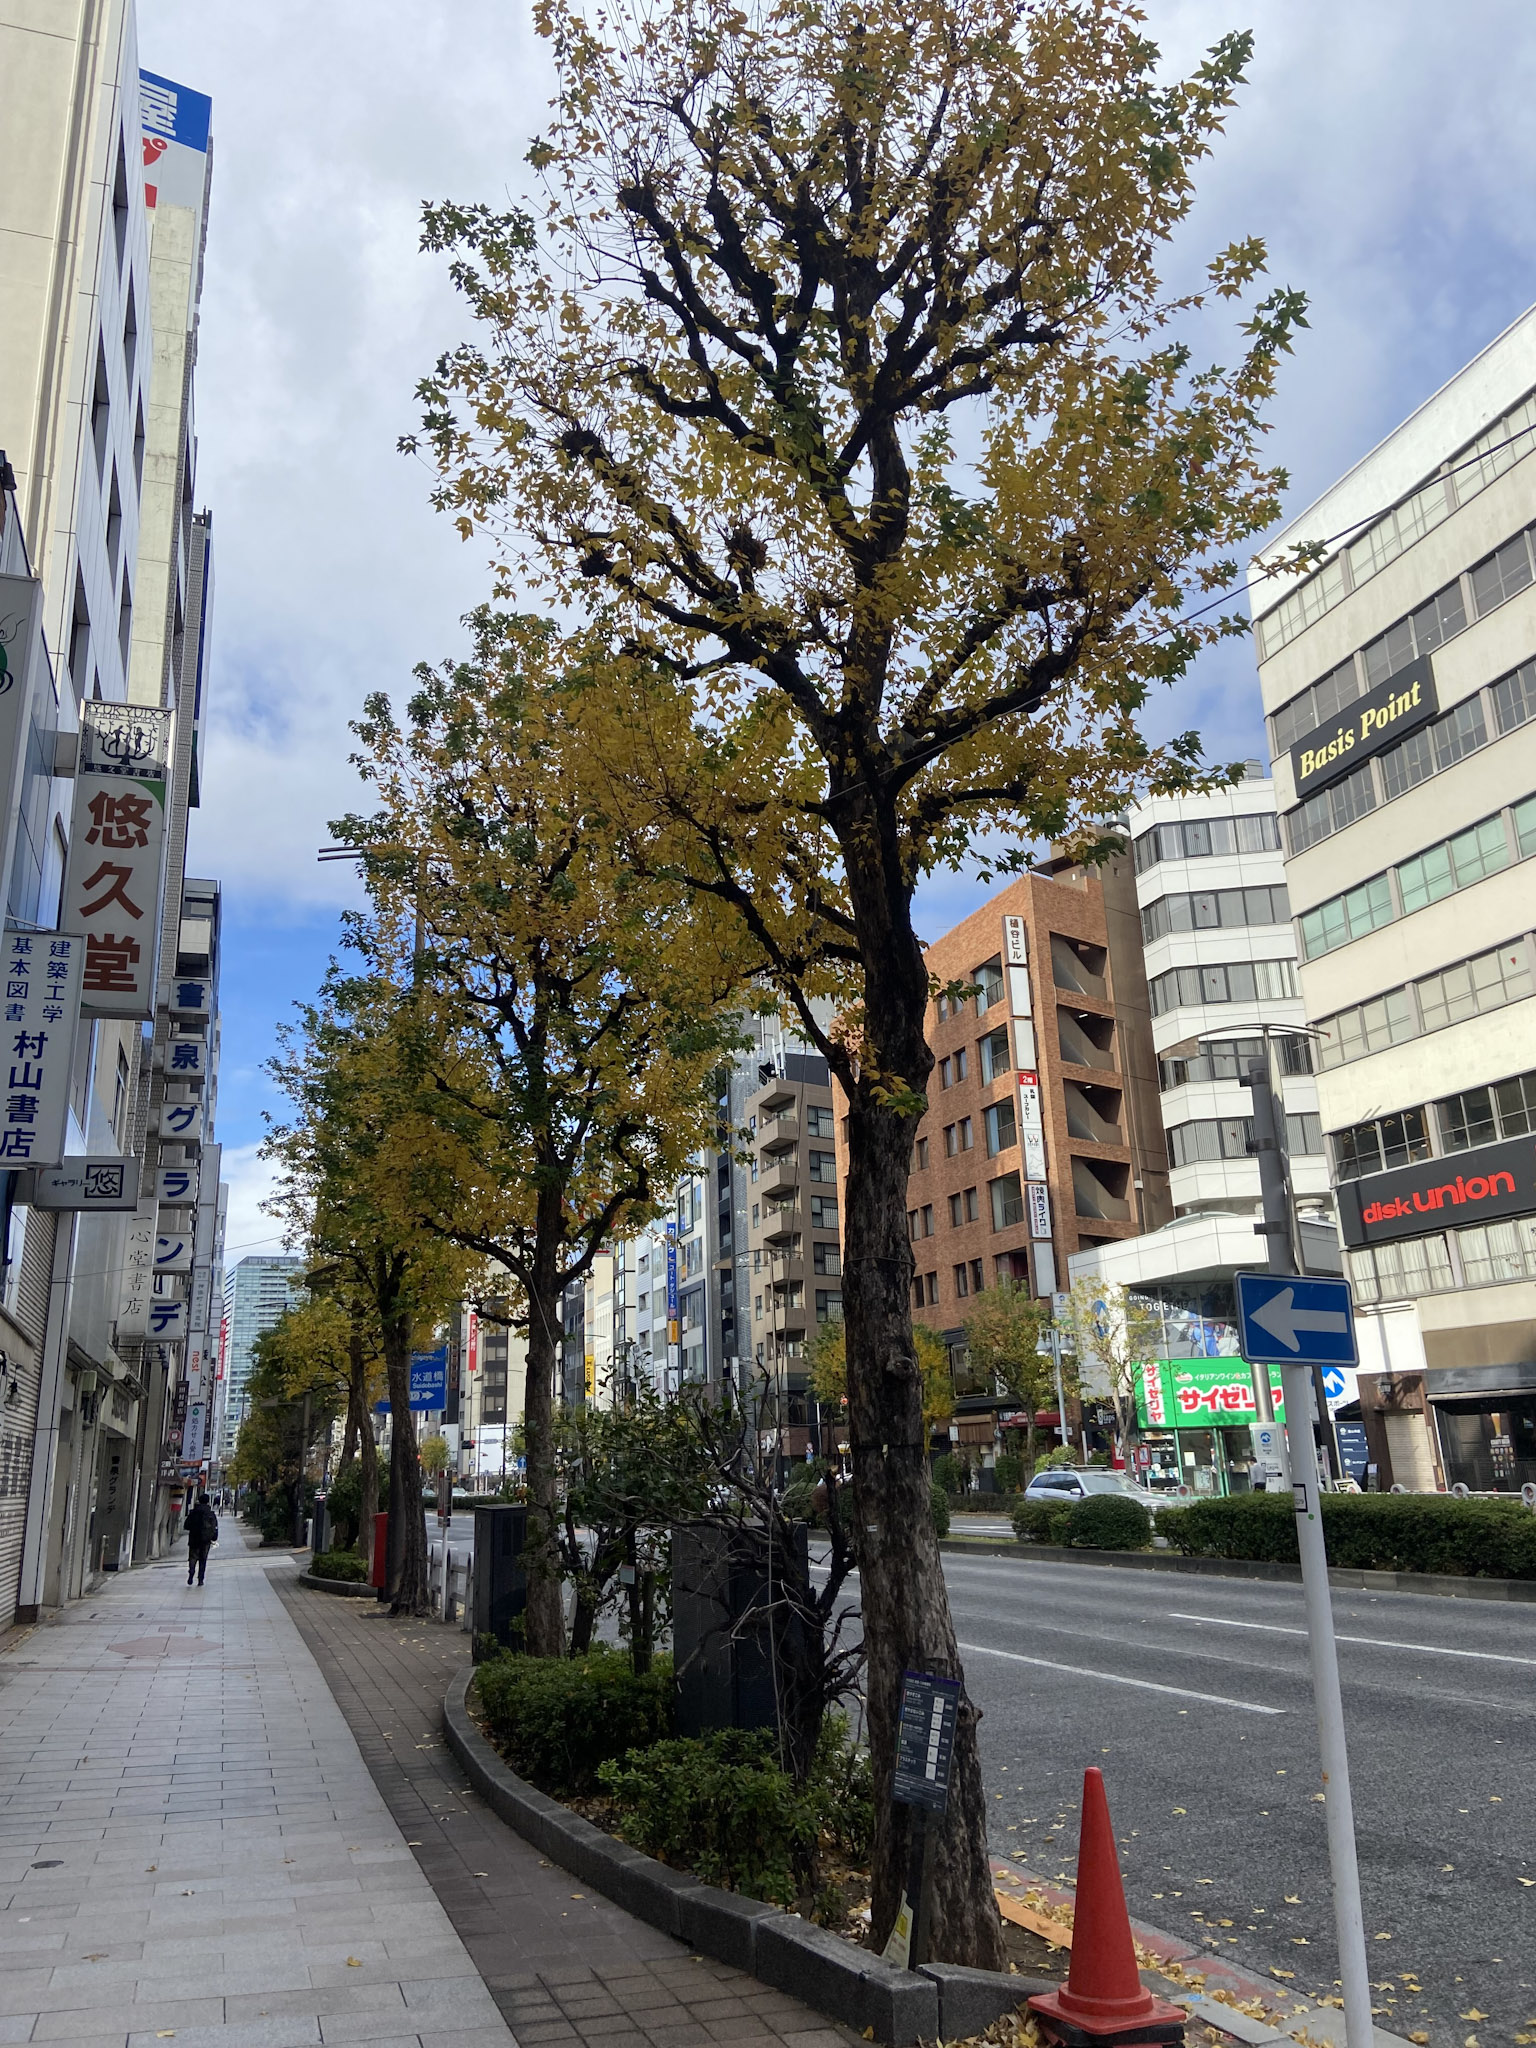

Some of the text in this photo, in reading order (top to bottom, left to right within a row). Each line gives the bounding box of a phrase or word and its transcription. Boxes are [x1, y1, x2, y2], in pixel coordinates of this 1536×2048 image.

[1300, 681, 1422, 780] Basis Point
[80, 790, 152, 992] 悠久堂
[5, 937, 33, 1021] 基本図書
[0, 1030, 48, 1158] 村山書店
[151, 982, 205, 1333] 書泉グランデ
[1363, 1171, 1516, 1224] disk union
[121, 1216, 152, 1316] 一心堂書店
[192, 1351, 200, 1372] nest
[412, 1371, 443, 1382] 水道橋
[1146, 1366, 1162, 1422] サイゼリヤ
